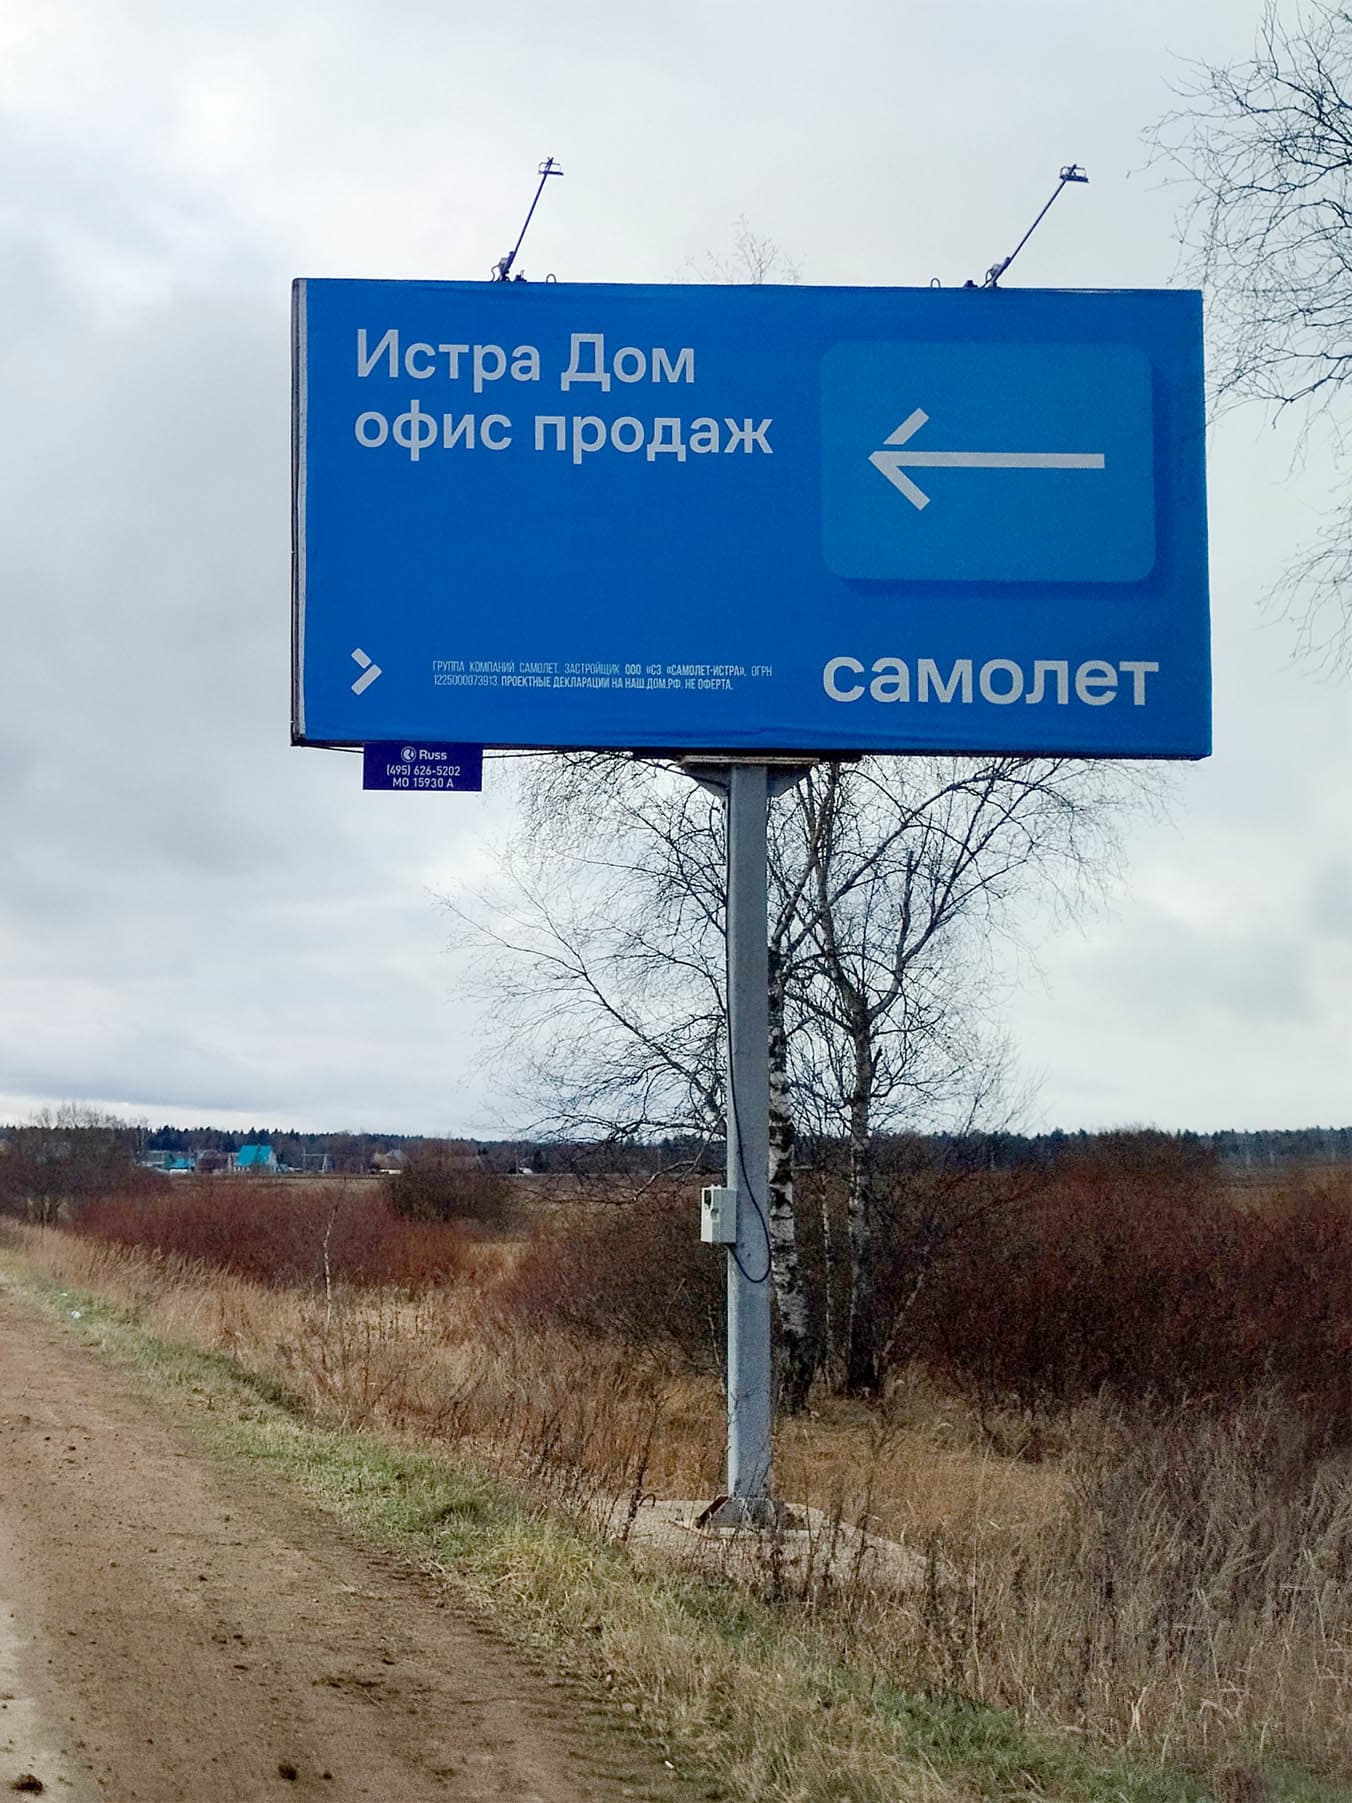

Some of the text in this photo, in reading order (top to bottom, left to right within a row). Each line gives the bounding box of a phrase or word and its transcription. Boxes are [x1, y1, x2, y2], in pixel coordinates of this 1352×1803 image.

[357, 328, 695, 393] Истра Дом
[354, 399, 774, 465] офис продаж
[432, 660, 465, 673] ГРУППА
[469, 660, 515, 673] КОМПАНИЙ
[564, 662, 620, 676] ЗАСТРОЙЩИК
[624, 664, 641, 675] ООО
[751, 665, 773, 677] ОГРН
[501, 675, 551, 688] ПРОЕКТНЫЕ
[553, 677, 609, 689] ДЕКЛАРАЦИИ
[612, 678, 623, 689] НА
[685, 679, 696, 690] НЕ
[697, 679, 734, 691] ОФЕРТА.
[823, 656, 1160, 706] самолет
[419, 749, 447, 760] Russ
[386, 764, 461, 777] (495) 626-5202
[413, 777, 444, 788] 15930
